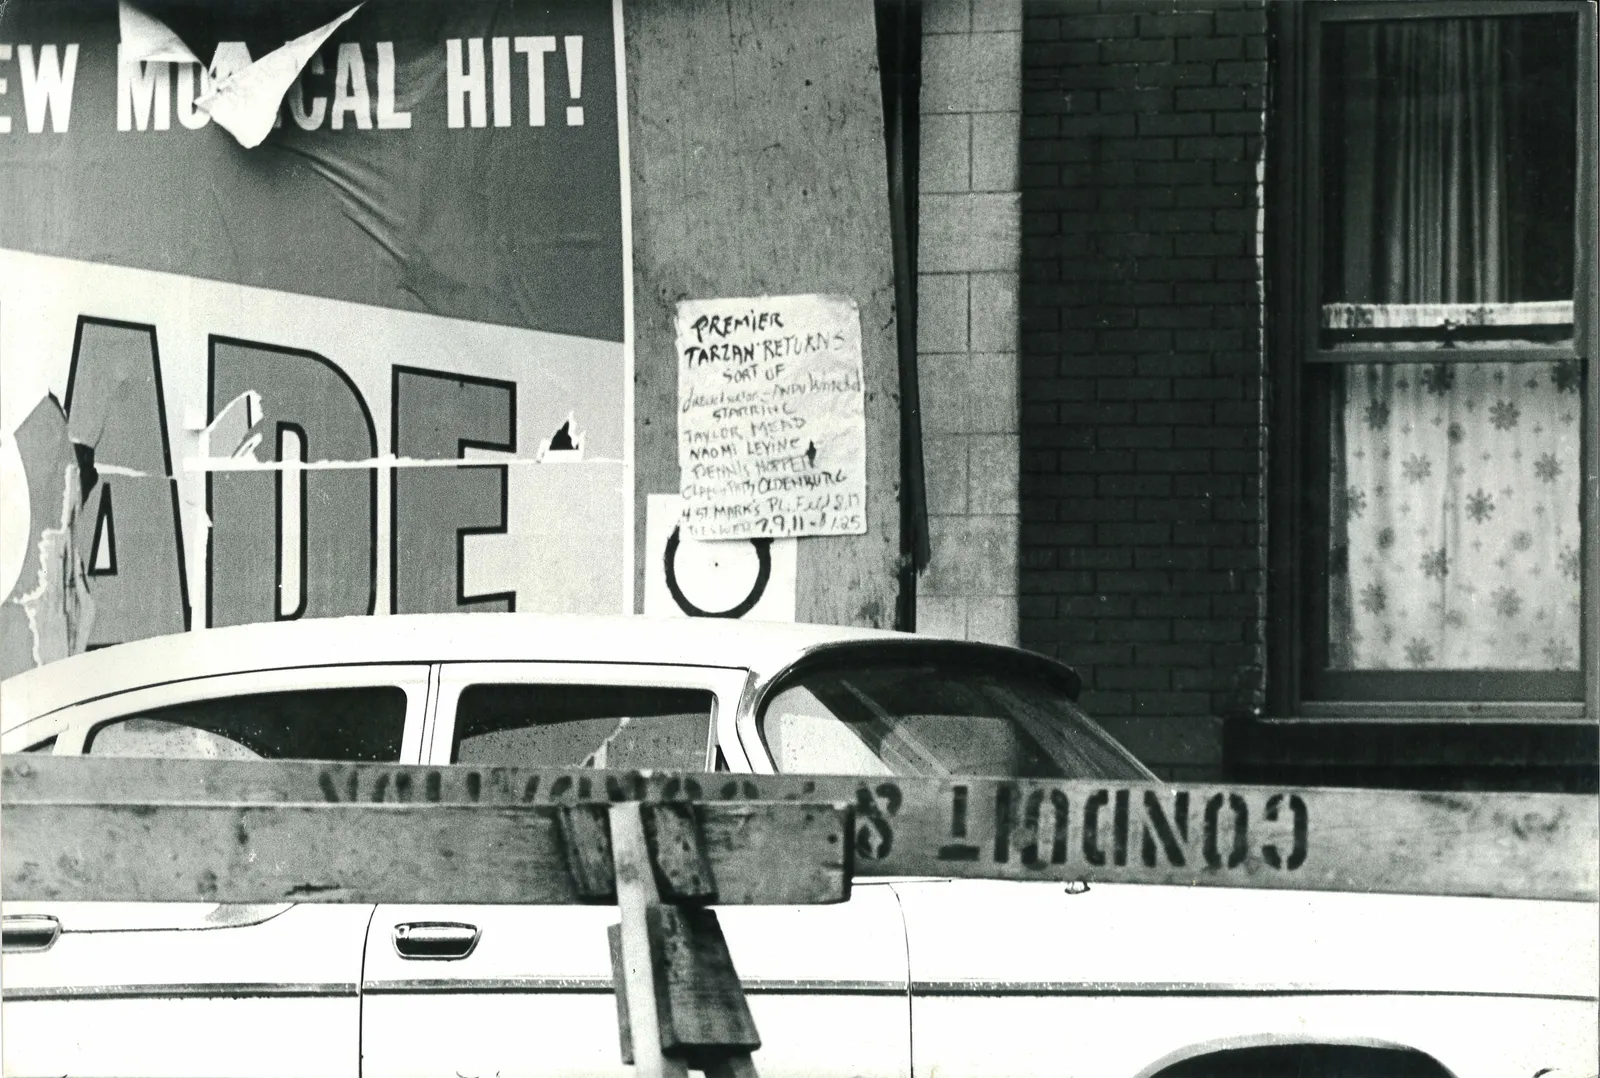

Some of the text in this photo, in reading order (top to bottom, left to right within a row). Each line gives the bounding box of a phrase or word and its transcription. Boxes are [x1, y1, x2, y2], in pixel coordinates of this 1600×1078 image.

[446, 35, 585, 129] HIT!
[691, 310, 784, 343] PREMIER
[684, 332, 845, 368] TARZAN RETURNS
[723, 364, 758, 384] SORT
[684, 417, 807, 444] TAYLOR MEAD
[690, 443, 737, 460] NAOMI
[758, 469, 847, 495] OLDENBURG
[682, 507, 691, 520] 4
